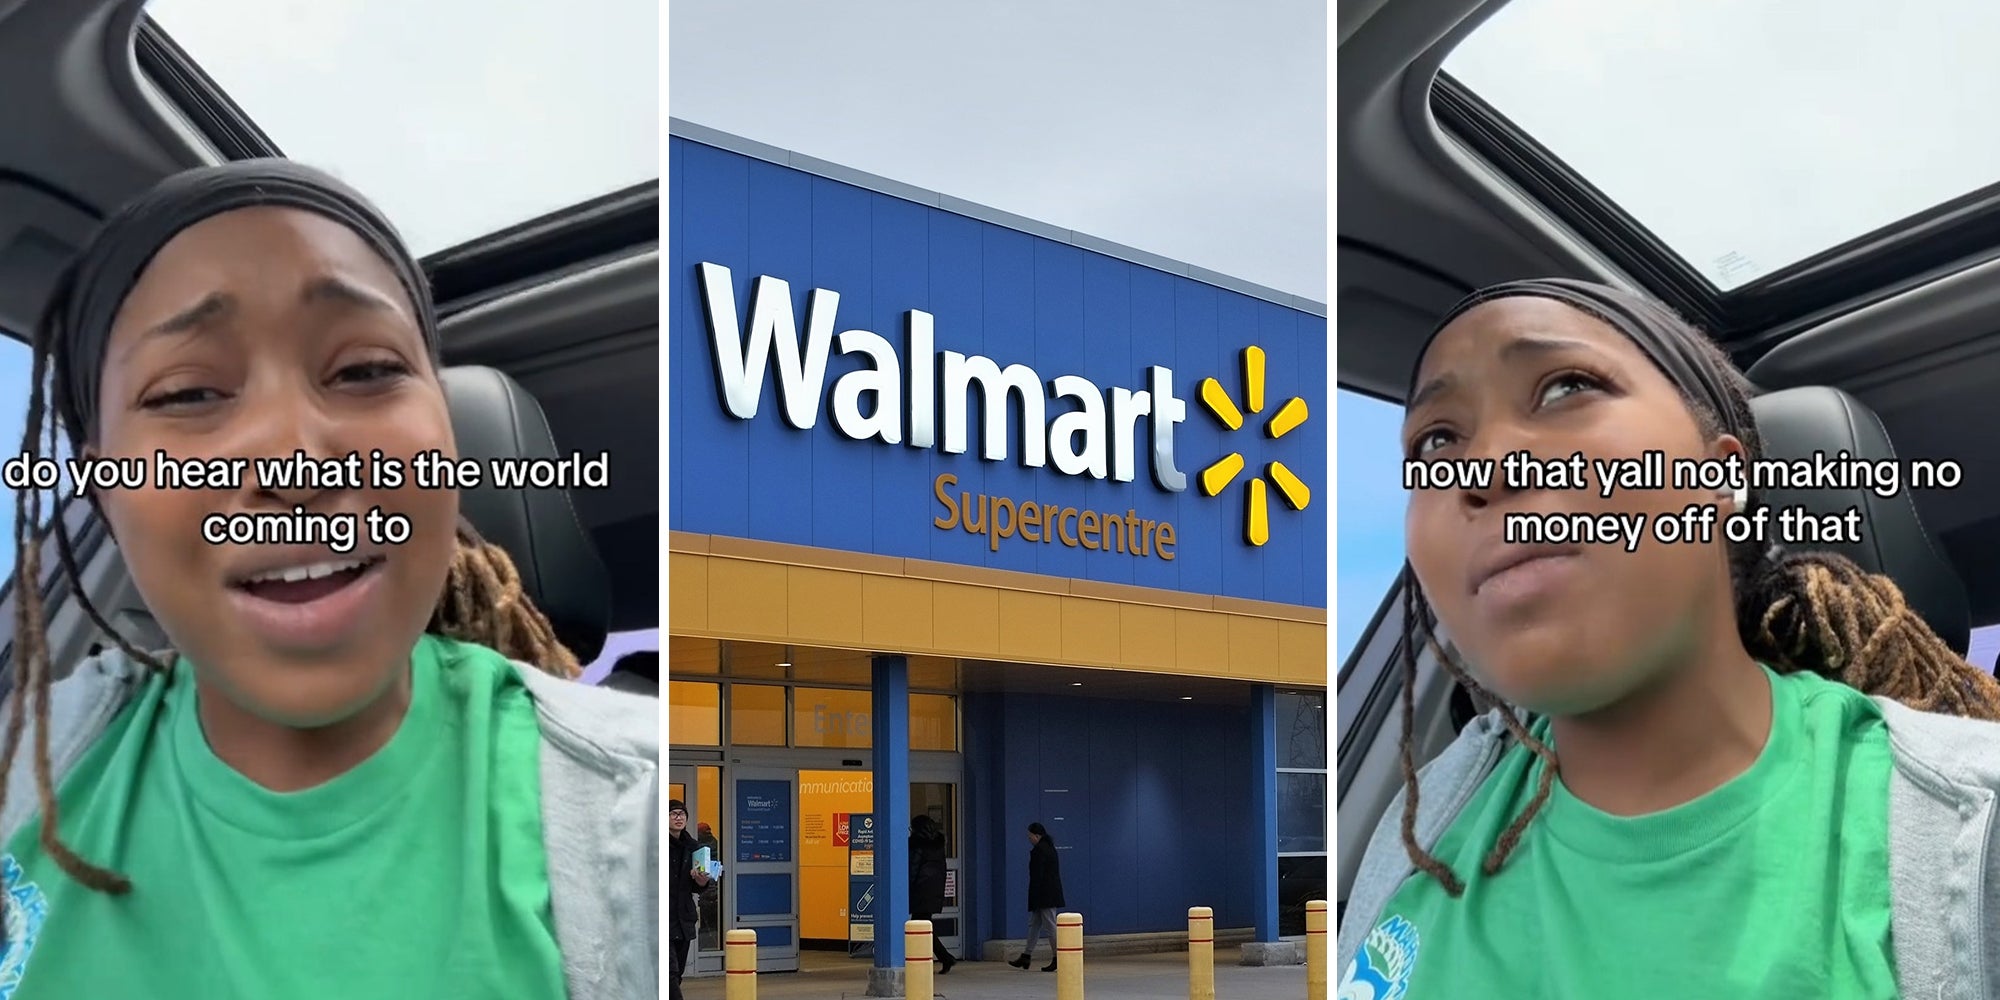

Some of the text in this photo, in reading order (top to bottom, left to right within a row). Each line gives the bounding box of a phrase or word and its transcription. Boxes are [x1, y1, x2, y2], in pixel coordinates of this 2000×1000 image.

[698, 260, 1188, 493] Walmart
[933, 473, 1177, 561] Supercentre
[814, 704, 872, 736] Ente
[747, 799, 771, 807] Walmart
